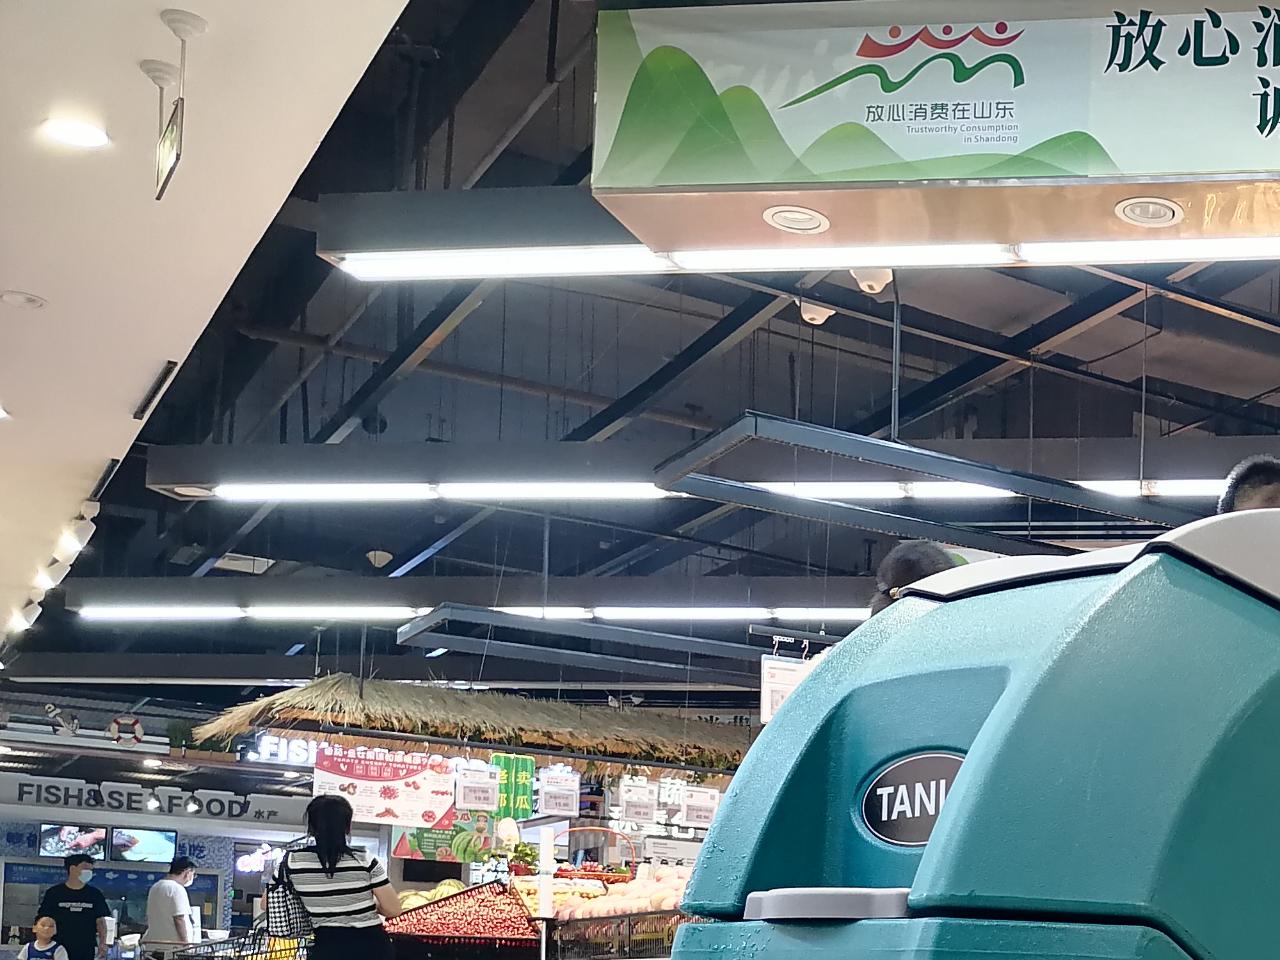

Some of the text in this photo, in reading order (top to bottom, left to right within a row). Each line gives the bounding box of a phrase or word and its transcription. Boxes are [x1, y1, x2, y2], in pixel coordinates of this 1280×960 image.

[866, 101, 1014, 122] 放心消费在山东
[907, 123, 1018, 134] Trustworthy Consumption
[974, 135, 1018, 144] Shandong
